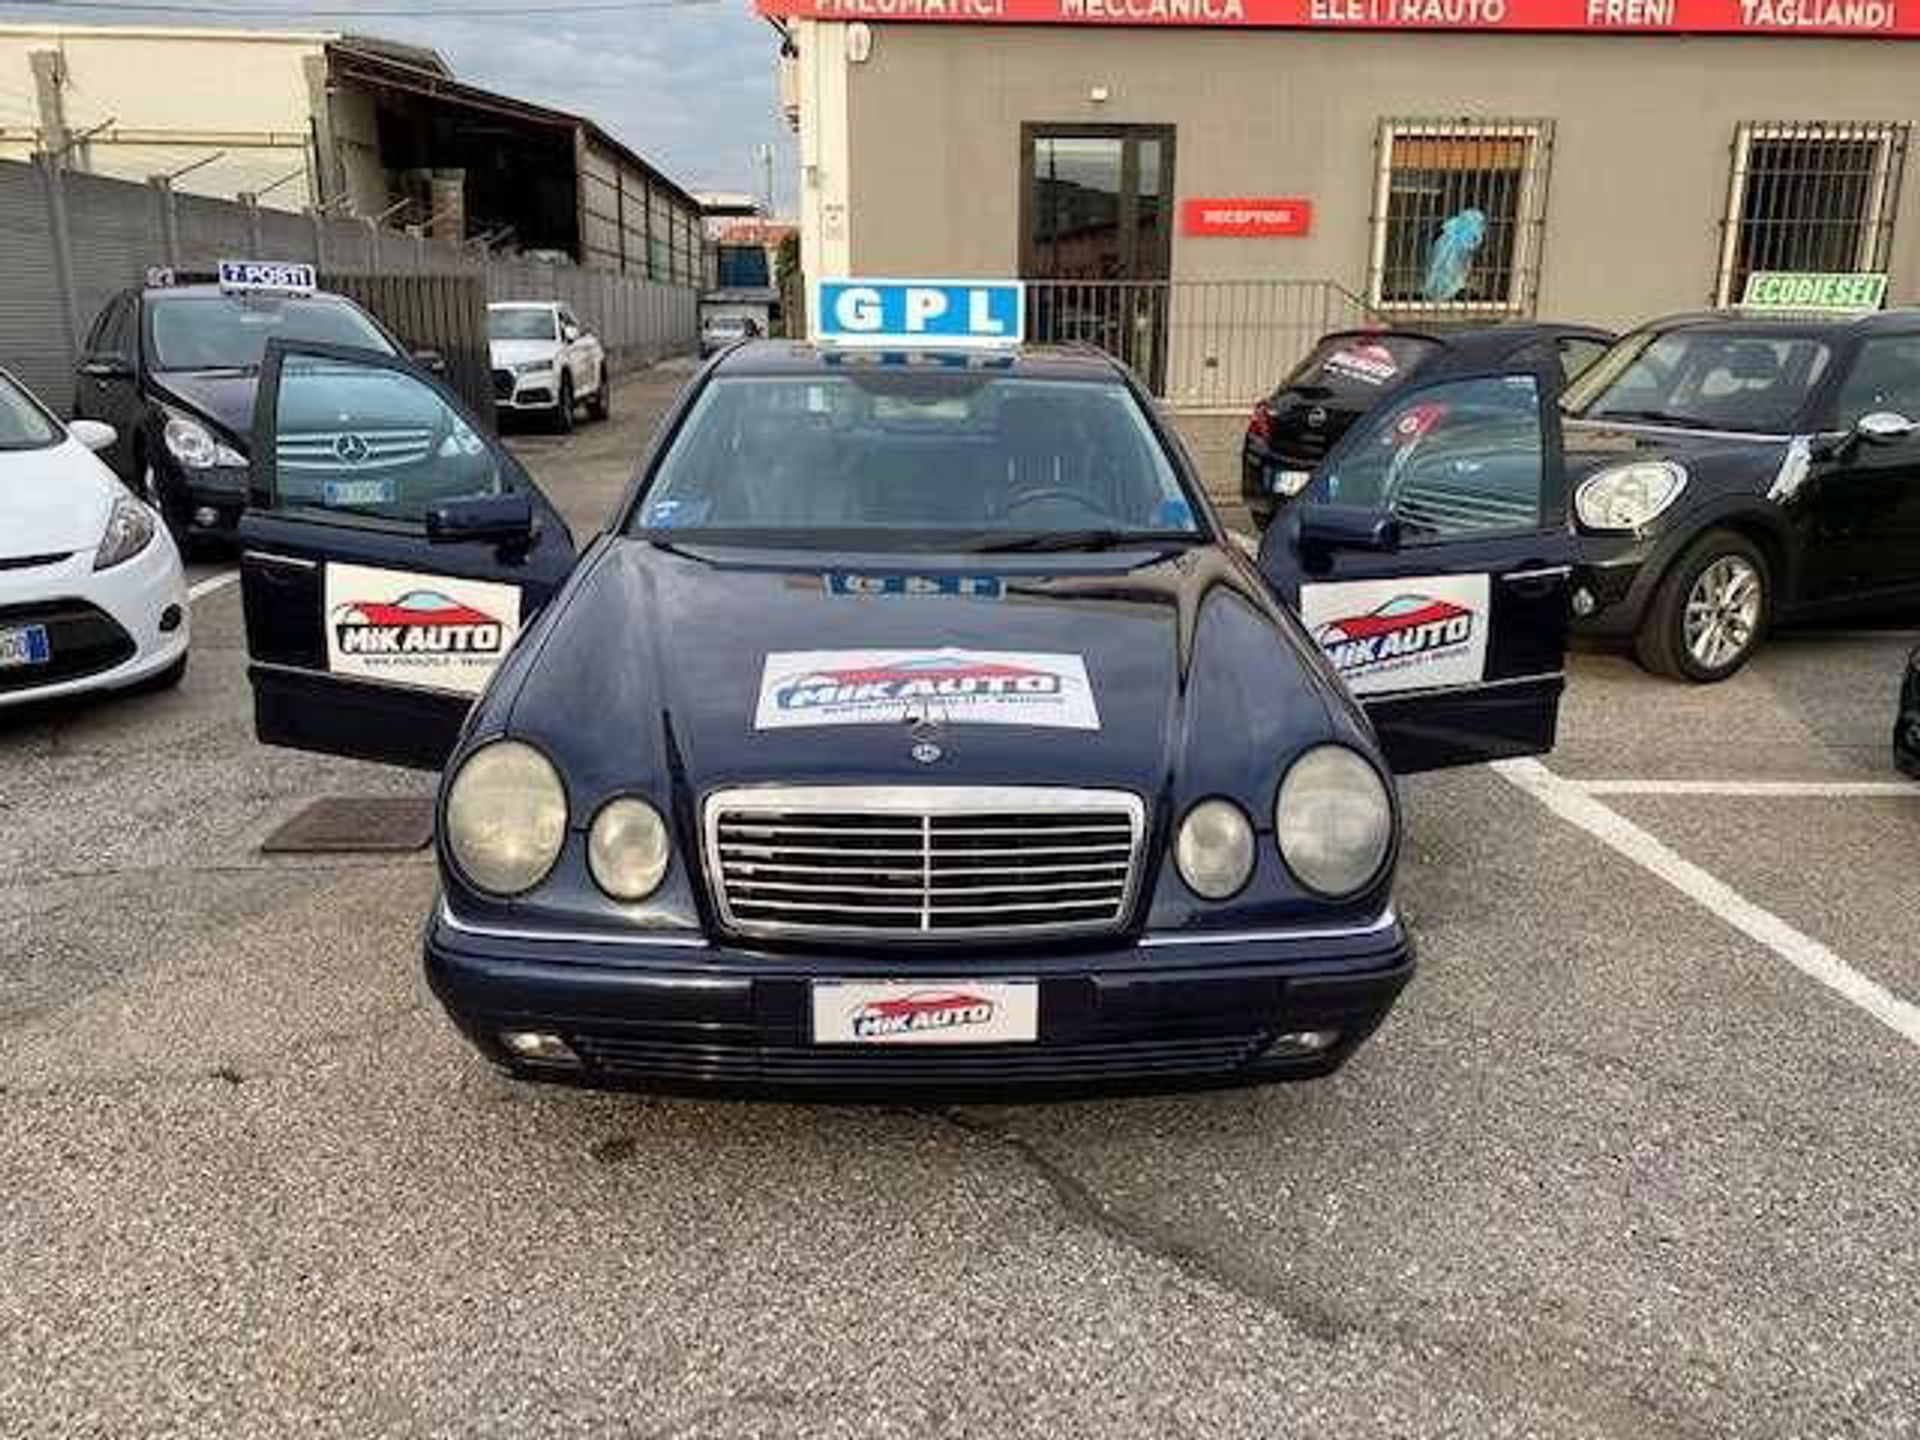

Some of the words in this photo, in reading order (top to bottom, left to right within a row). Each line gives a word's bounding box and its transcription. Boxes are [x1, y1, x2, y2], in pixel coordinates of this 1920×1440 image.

[1058, 0, 1245, 19] MECCANICA
[1310, 0, 1505, 22] ELETTRAUTO
[1586, 0, 1674, 25] FRENI
[1740, 0, 1895, 27] TAGLIANDI
[1751, 276, 1875, 305] ECODIESEL
[836, 287, 1004, 333] GPL
